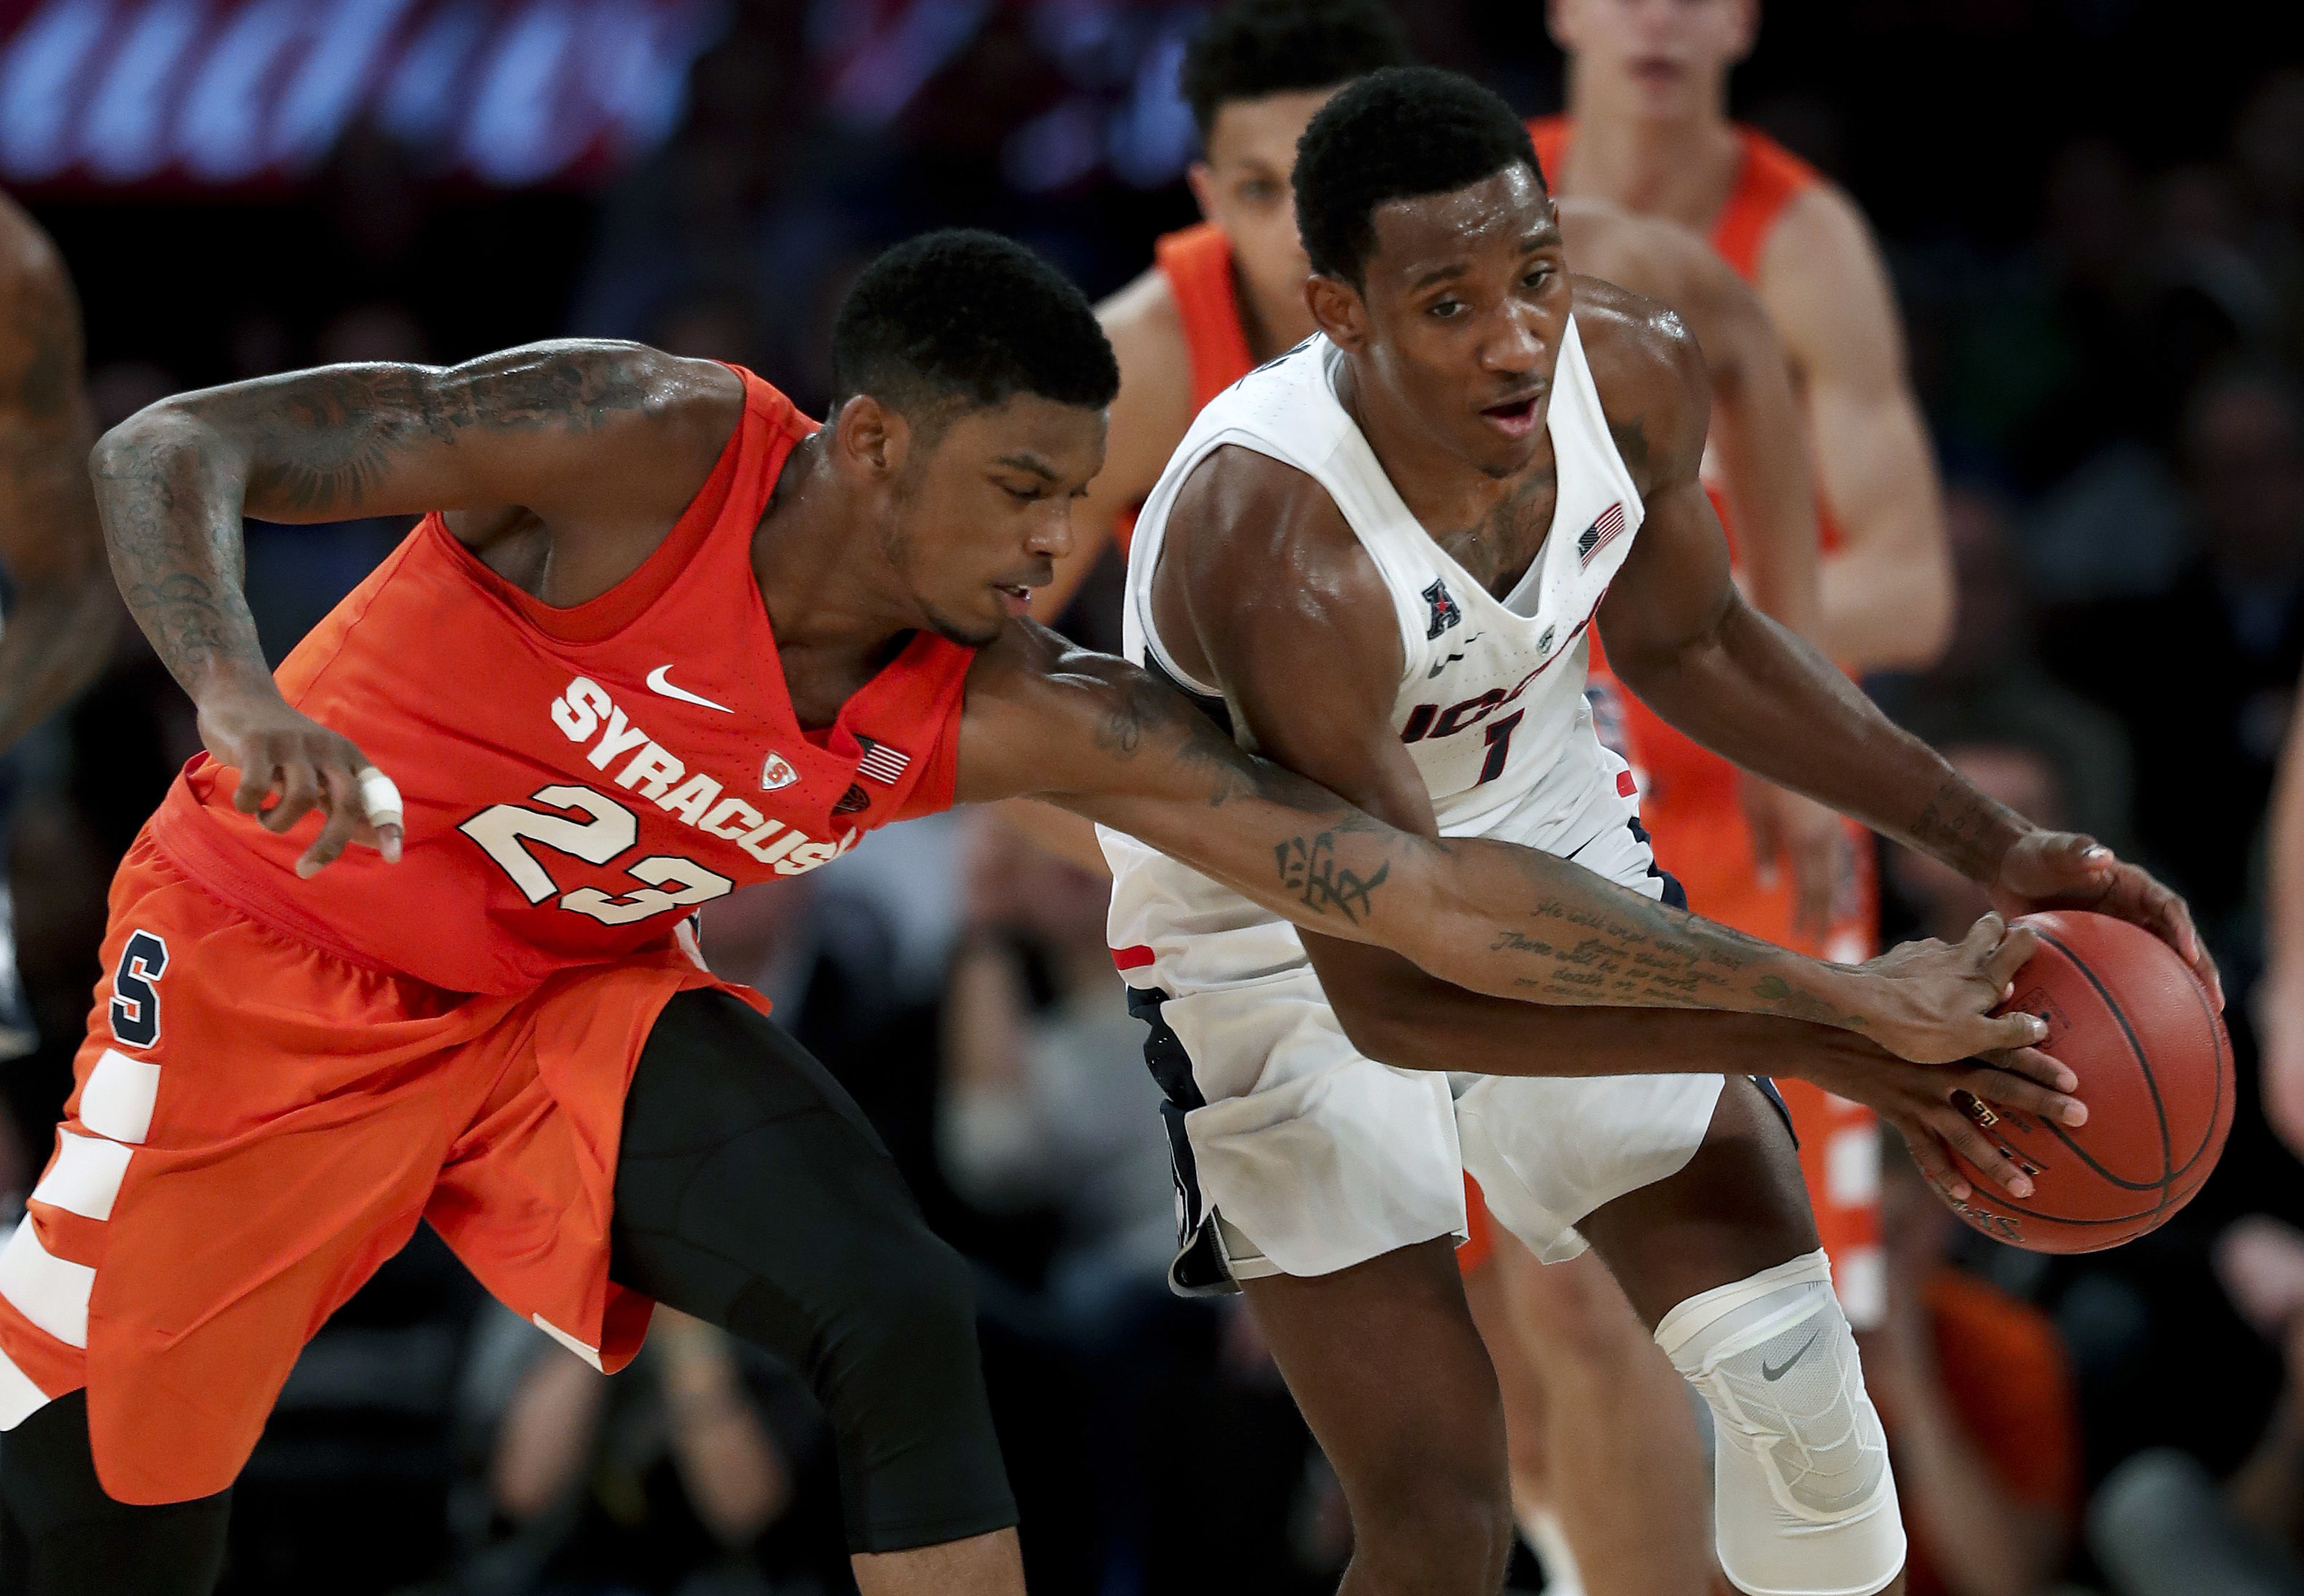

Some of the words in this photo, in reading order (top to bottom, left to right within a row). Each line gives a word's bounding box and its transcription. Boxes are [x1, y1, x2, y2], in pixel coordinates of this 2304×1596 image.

[1474, 708, 1525, 785] 1
[456, 784, 734, 925] 23
[109, 928, 171, 1050] S
